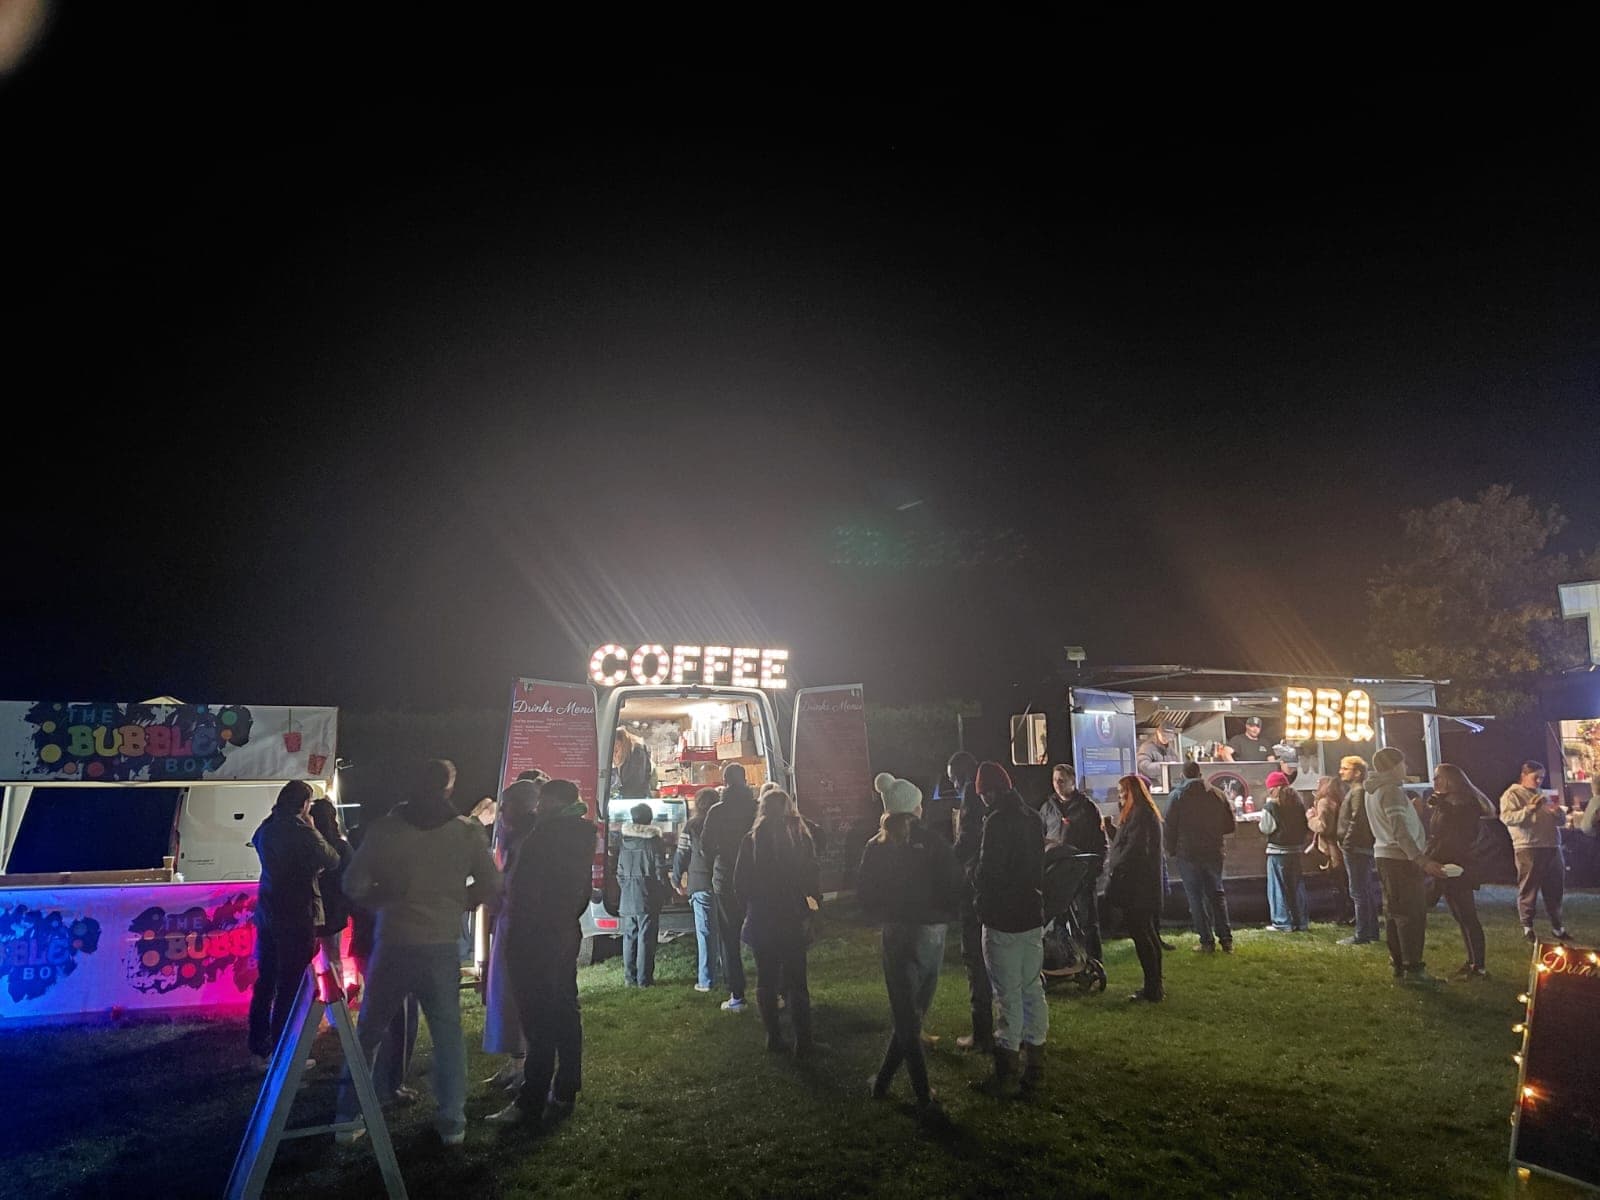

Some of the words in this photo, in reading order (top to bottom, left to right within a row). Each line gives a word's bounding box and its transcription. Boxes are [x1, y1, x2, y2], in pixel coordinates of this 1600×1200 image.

[589, 644, 789, 690] COFFEE
[67, 708, 113, 723] THE
[513, 700, 554, 713] Drinks
[556, 701, 594, 716] Menu
[1285, 686, 1375, 742] BBQ
[67, 724, 219, 757] BUBBLE
[165, 758, 214, 773] BOX
[164, 915, 203, 931] THE
